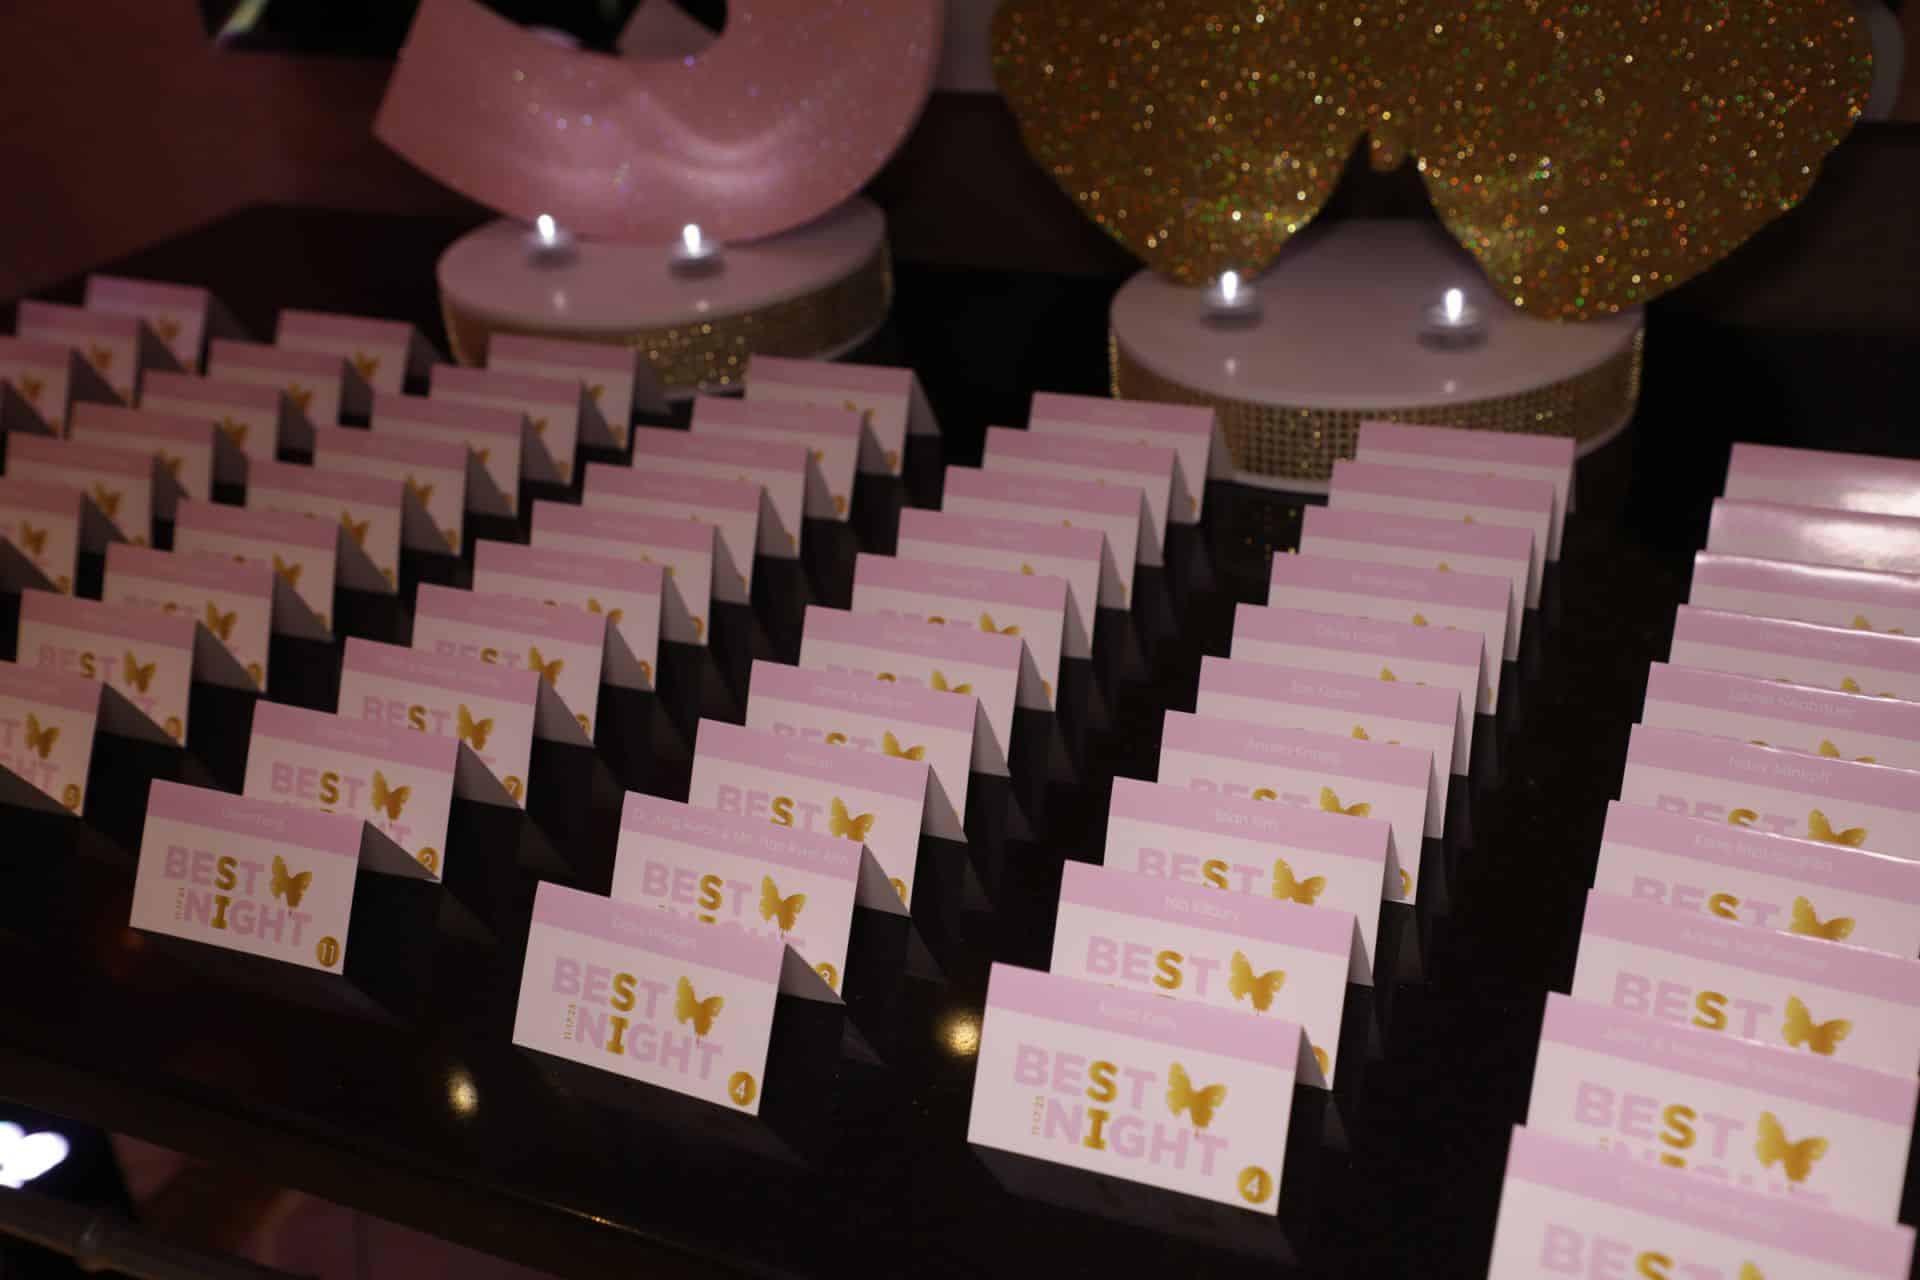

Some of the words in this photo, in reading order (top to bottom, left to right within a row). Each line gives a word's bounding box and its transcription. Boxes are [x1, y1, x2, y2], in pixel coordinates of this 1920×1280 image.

[272, 761, 365, 809] BEST
[717, 784, 824, 832] BEST
[164, 844, 264, 896] BEST
[642, 863, 752, 915] BEST
[1137, 848, 1264, 896] BEST
[184, 889, 312, 946] NIGHT
[554, 957, 669, 1018] BEST
[1085, 935, 1219, 995] BEST
[1612, 969, 1773, 1038] BEST
[576, 1006, 724, 1080] NIGHT
[1014, 1041, 1156, 1109] BEST
[1044, 1098, 1229, 1177] NIGHT
[1574, 1081, 1744, 1159] BEST
